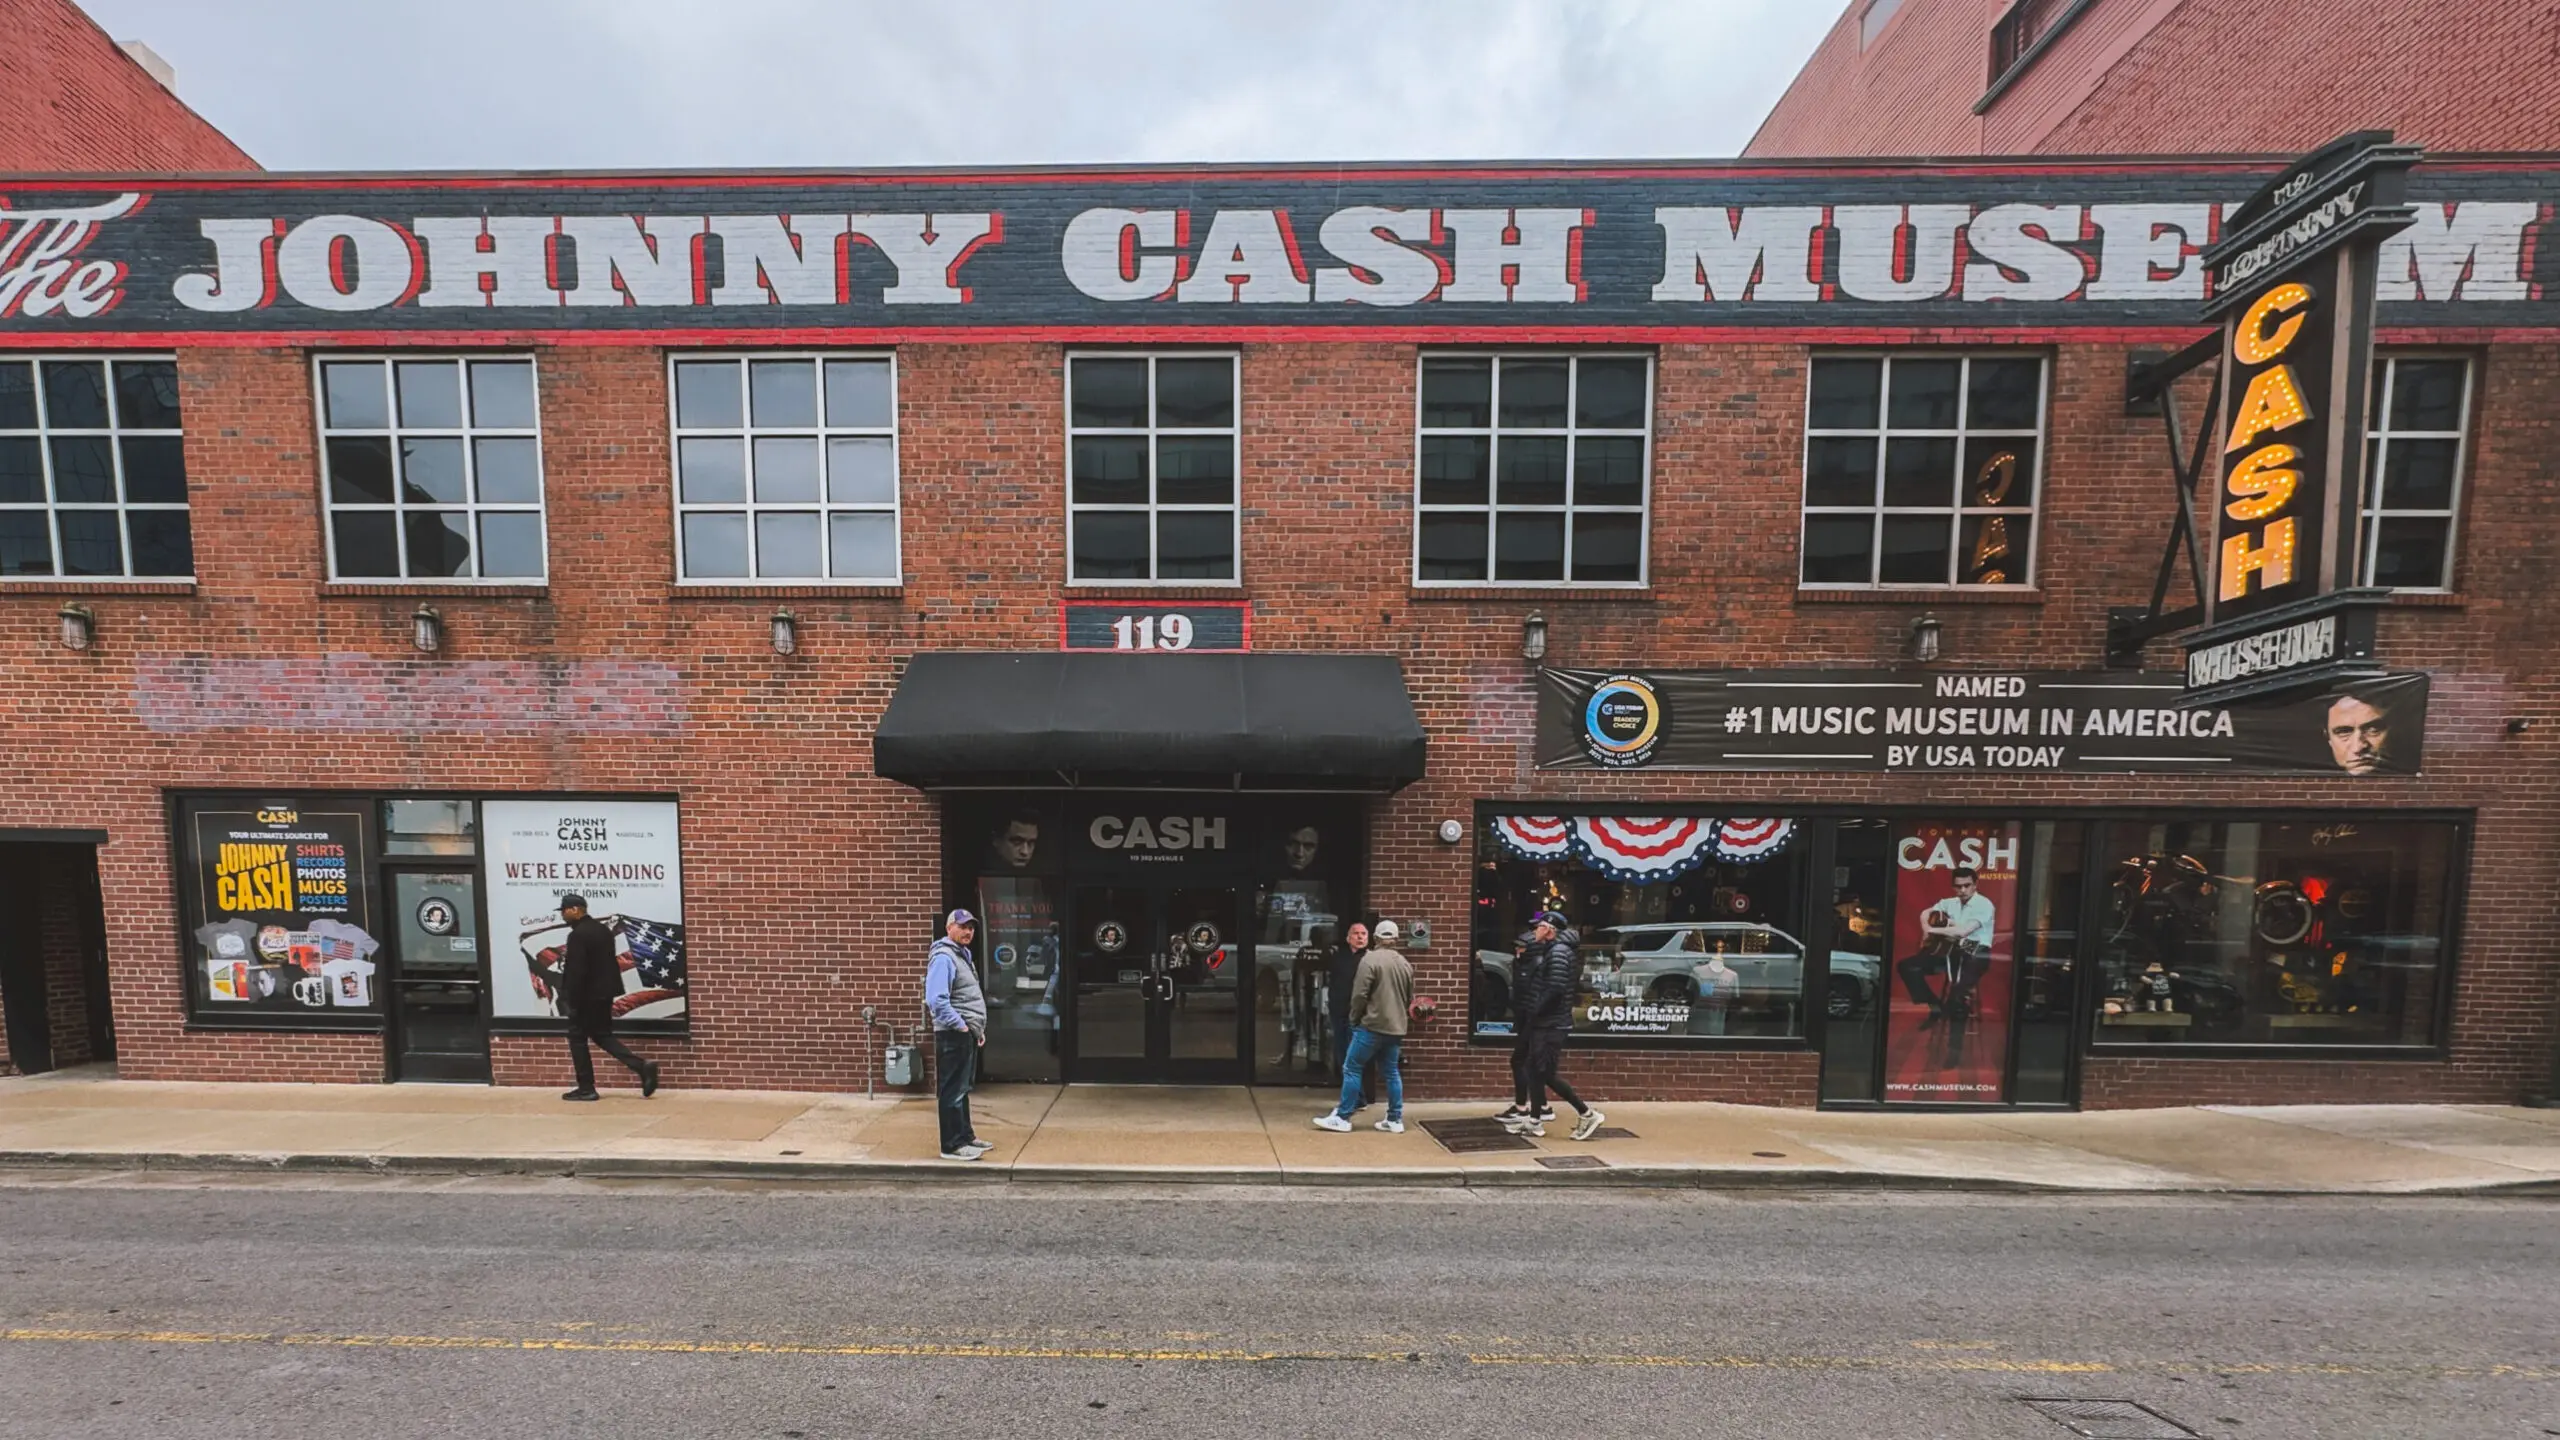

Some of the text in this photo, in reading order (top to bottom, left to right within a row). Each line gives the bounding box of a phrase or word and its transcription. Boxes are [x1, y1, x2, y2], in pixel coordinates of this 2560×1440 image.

[2214, 181, 2365, 292] JOHNNY
[0, 192, 2546, 318] The JOHNNY CASH MUSEM
[2219, 283, 2312, 602] CASH
[1112, 614, 1193, 651] 119
[2189, 616, 2336, 688] MUSEUM
[1935, 675, 2026, 698] NAMED
[1723, 706, 2235, 738] #1 MUSIC MUSEUM IN AMERICA
[1886, 745, 2065, 768] BY USA TODAY
[257, 811, 298, 823] CASH
[558, 817, 607, 827] JOHNNY
[229, 831, 249, 839] YOUR
[250, 832, 283, 840] ULTIMATE
[284, 832, 312, 840] SOURCE
[557, 827, 607, 841] CASH
[1089, 815, 1226, 850] CASH
[1917, 828, 1999, 836] JOHNNY
[296, 844, 345, 857] SHIRTS
[558, 842, 609, 851] MUSEUM
[1897, 836, 2017, 871] CASH
[216, 842, 288, 876] JOHNNY
[296, 857, 346, 867] RECORDS
[297, 868, 347, 879] PHOTOS
[505, 862, 665, 880] WE'RE EXPANDING
[1979, 872, 2017, 881] MUSEUM
[217, 861, 293, 912] CASH
[298, 880, 348, 895] MUGS
[299, 895, 348, 905] POSTERS
[582, 889, 619, 899] JOHNNY
[989, 902, 1054, 913] THANK YOU
[520, 914, 556, 926] Coming
[1587, 1005, 1640, 1022] CASH
[1640, 1013, 1690, 1022] PRESIDENT
[1886, 1083, 1997, 1092] WWW.CASHMUSEUM.COM
